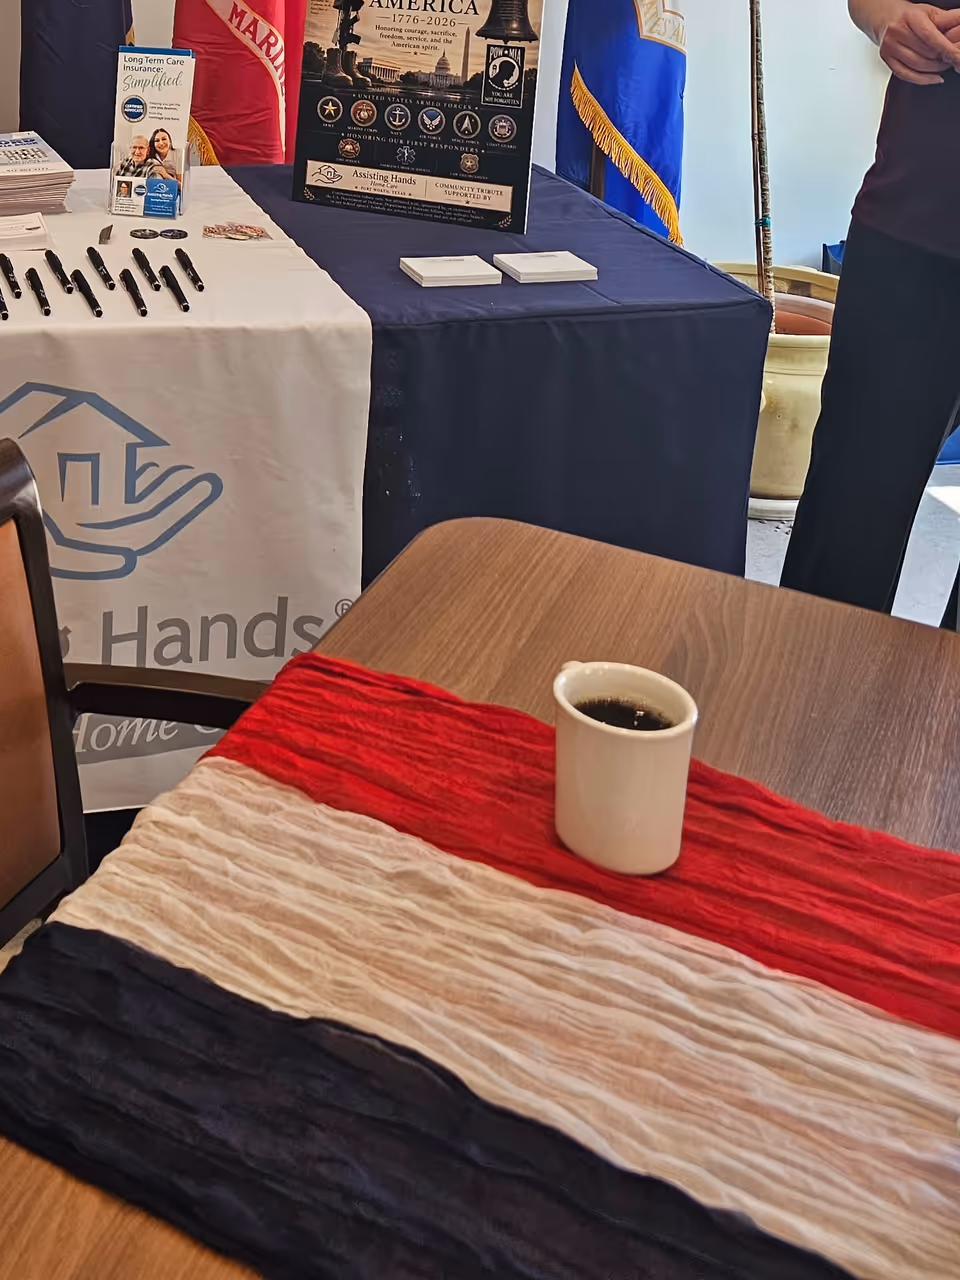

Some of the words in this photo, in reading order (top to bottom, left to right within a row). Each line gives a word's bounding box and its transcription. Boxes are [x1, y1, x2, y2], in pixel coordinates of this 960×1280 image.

[375, 24, 403, 34] Honoring
[404, 27, 430, 36] courage,
[430, 29, 458, 38] sacrifice,
[379, 32, 406, 41] freedom,
[406, 35, 429, 43] service,
[430, 36, 442, 44] and
[442, 37, 453, 45] the
[391, 41, 420, 50] American
[421, 43, 440, 51] spirit.
[123, 55, 144, 65] Long
[144, 55, 165, 64] Term
[166, 57, 185, 66] Care
[489, 46, 504, 63] POW
[509, 48, 522, 67] MIA
[123, 64, 164, 73] Insurance:
[358, 93, 385, 101] UNITED
[387, 96, 413, 104] STATES
[493, 97, 520, 105] FORGOTTEN
[346, 133, 386, 142] HONORING
[388, 137, 404, 145] OUR
[430, 142, 479, 153] RESPONDERS
[352, 169, 389, 183] Assisting
[390, 174, 417, 185] Hands
[386, 182, 399, 190] Care
[435, 182, 475, 192] COMMUNITY
[476, 187, 503, 196] TRIBUTE
[444, 190, 481, 200] SUPPORTED
